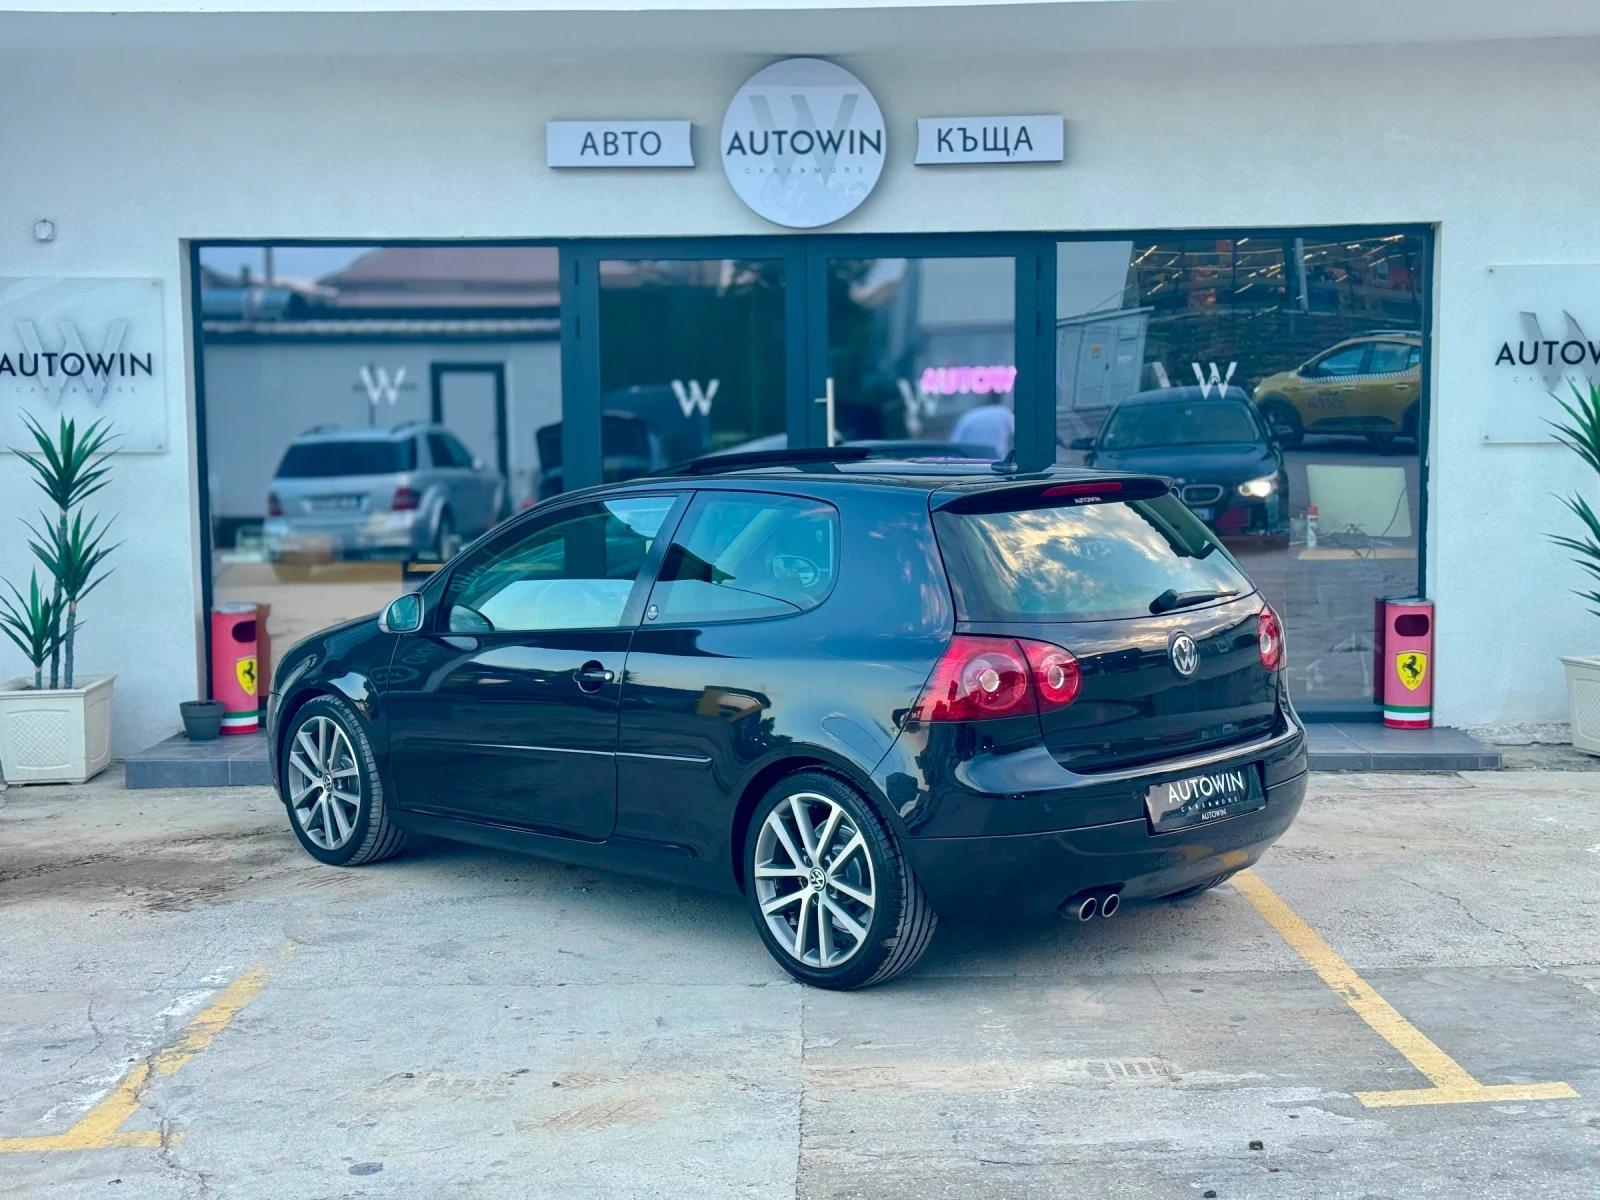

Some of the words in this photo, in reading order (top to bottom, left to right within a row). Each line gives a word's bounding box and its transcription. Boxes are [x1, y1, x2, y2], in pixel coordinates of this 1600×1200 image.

[580, 130, 662, 156] АВТО
[727, 129, 882, 156] AUTOWIN
[937, 125, 1033, 157] КЪЩА
[0, 352, 152, 377] AUTOWIN
[1495, 340, 1600, 366] AUTO
[16, 386, 136, 394] CARS&MORE
[359, 366, 406, 405] W
[920, 365, 1017, 394] AUTOW
[1191, 361, 1238, 400] W
[671, 378, 720, 418] W
[1168, 771, 1244, 803] AUTOWIN
[1201, 808, 1227, 821] AUTOWIN
